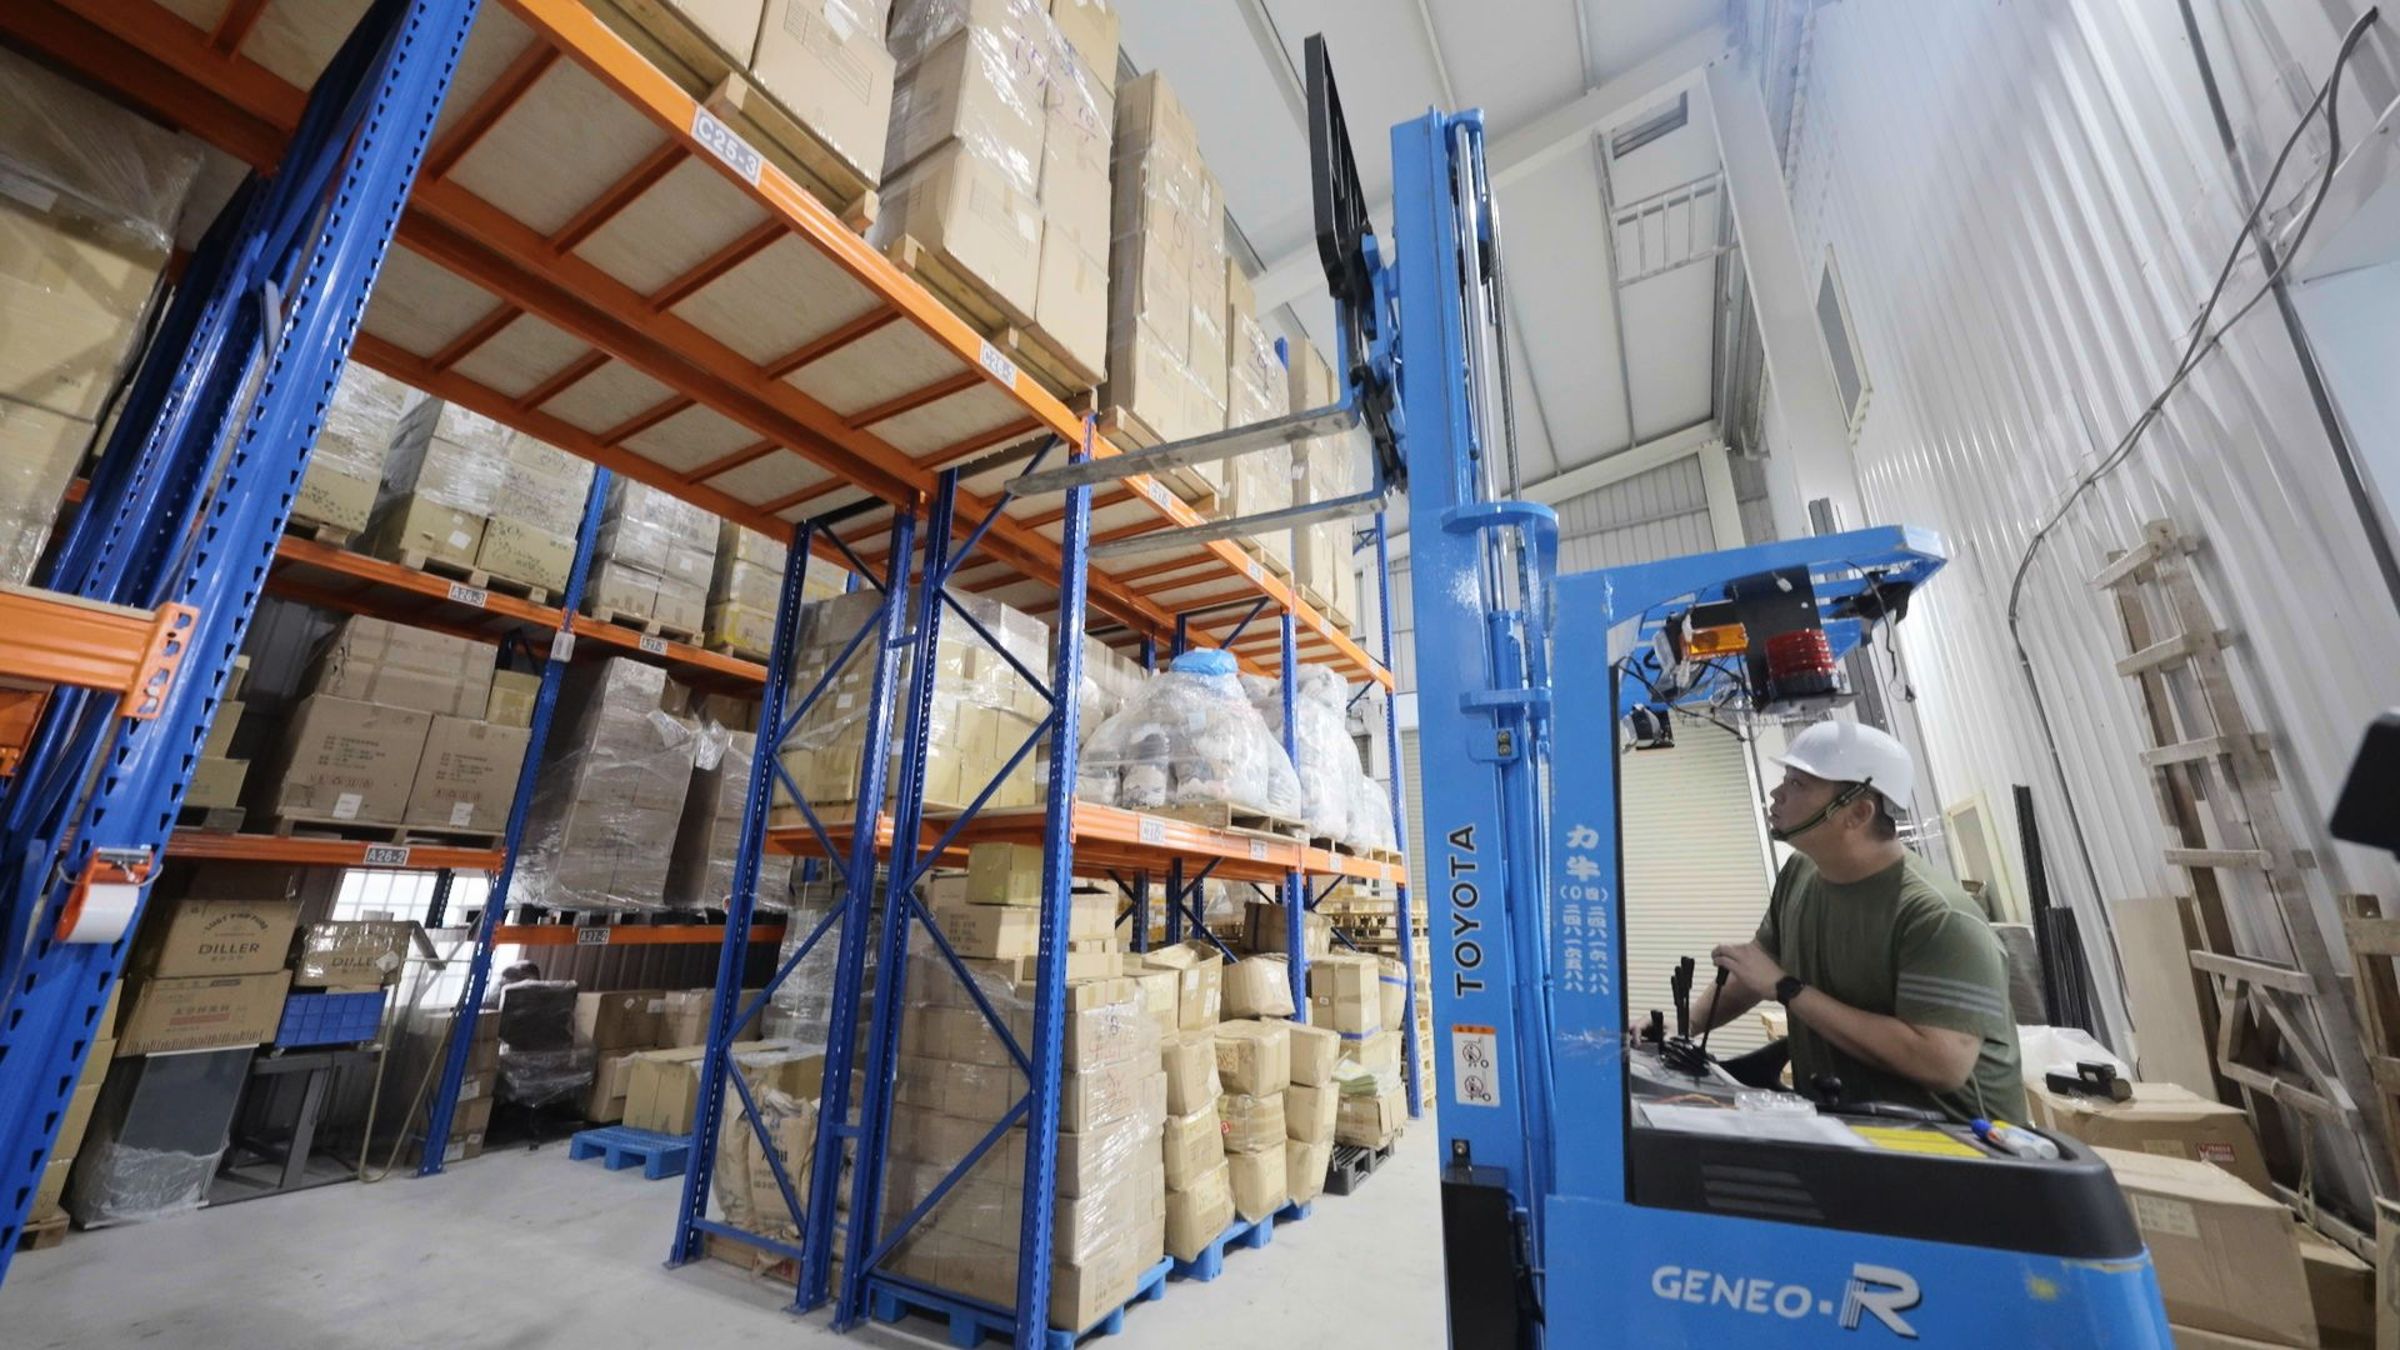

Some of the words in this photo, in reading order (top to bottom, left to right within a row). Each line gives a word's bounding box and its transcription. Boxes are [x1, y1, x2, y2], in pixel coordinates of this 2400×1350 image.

[698, 115, 757, 175] C25-3
[367, 849, 405, 863] A26-2
[1449, 825, 1484, 997] TOYOTA
[198, 943, 261, 954] DILLER
[331, 956, 379, 968] DILLE
